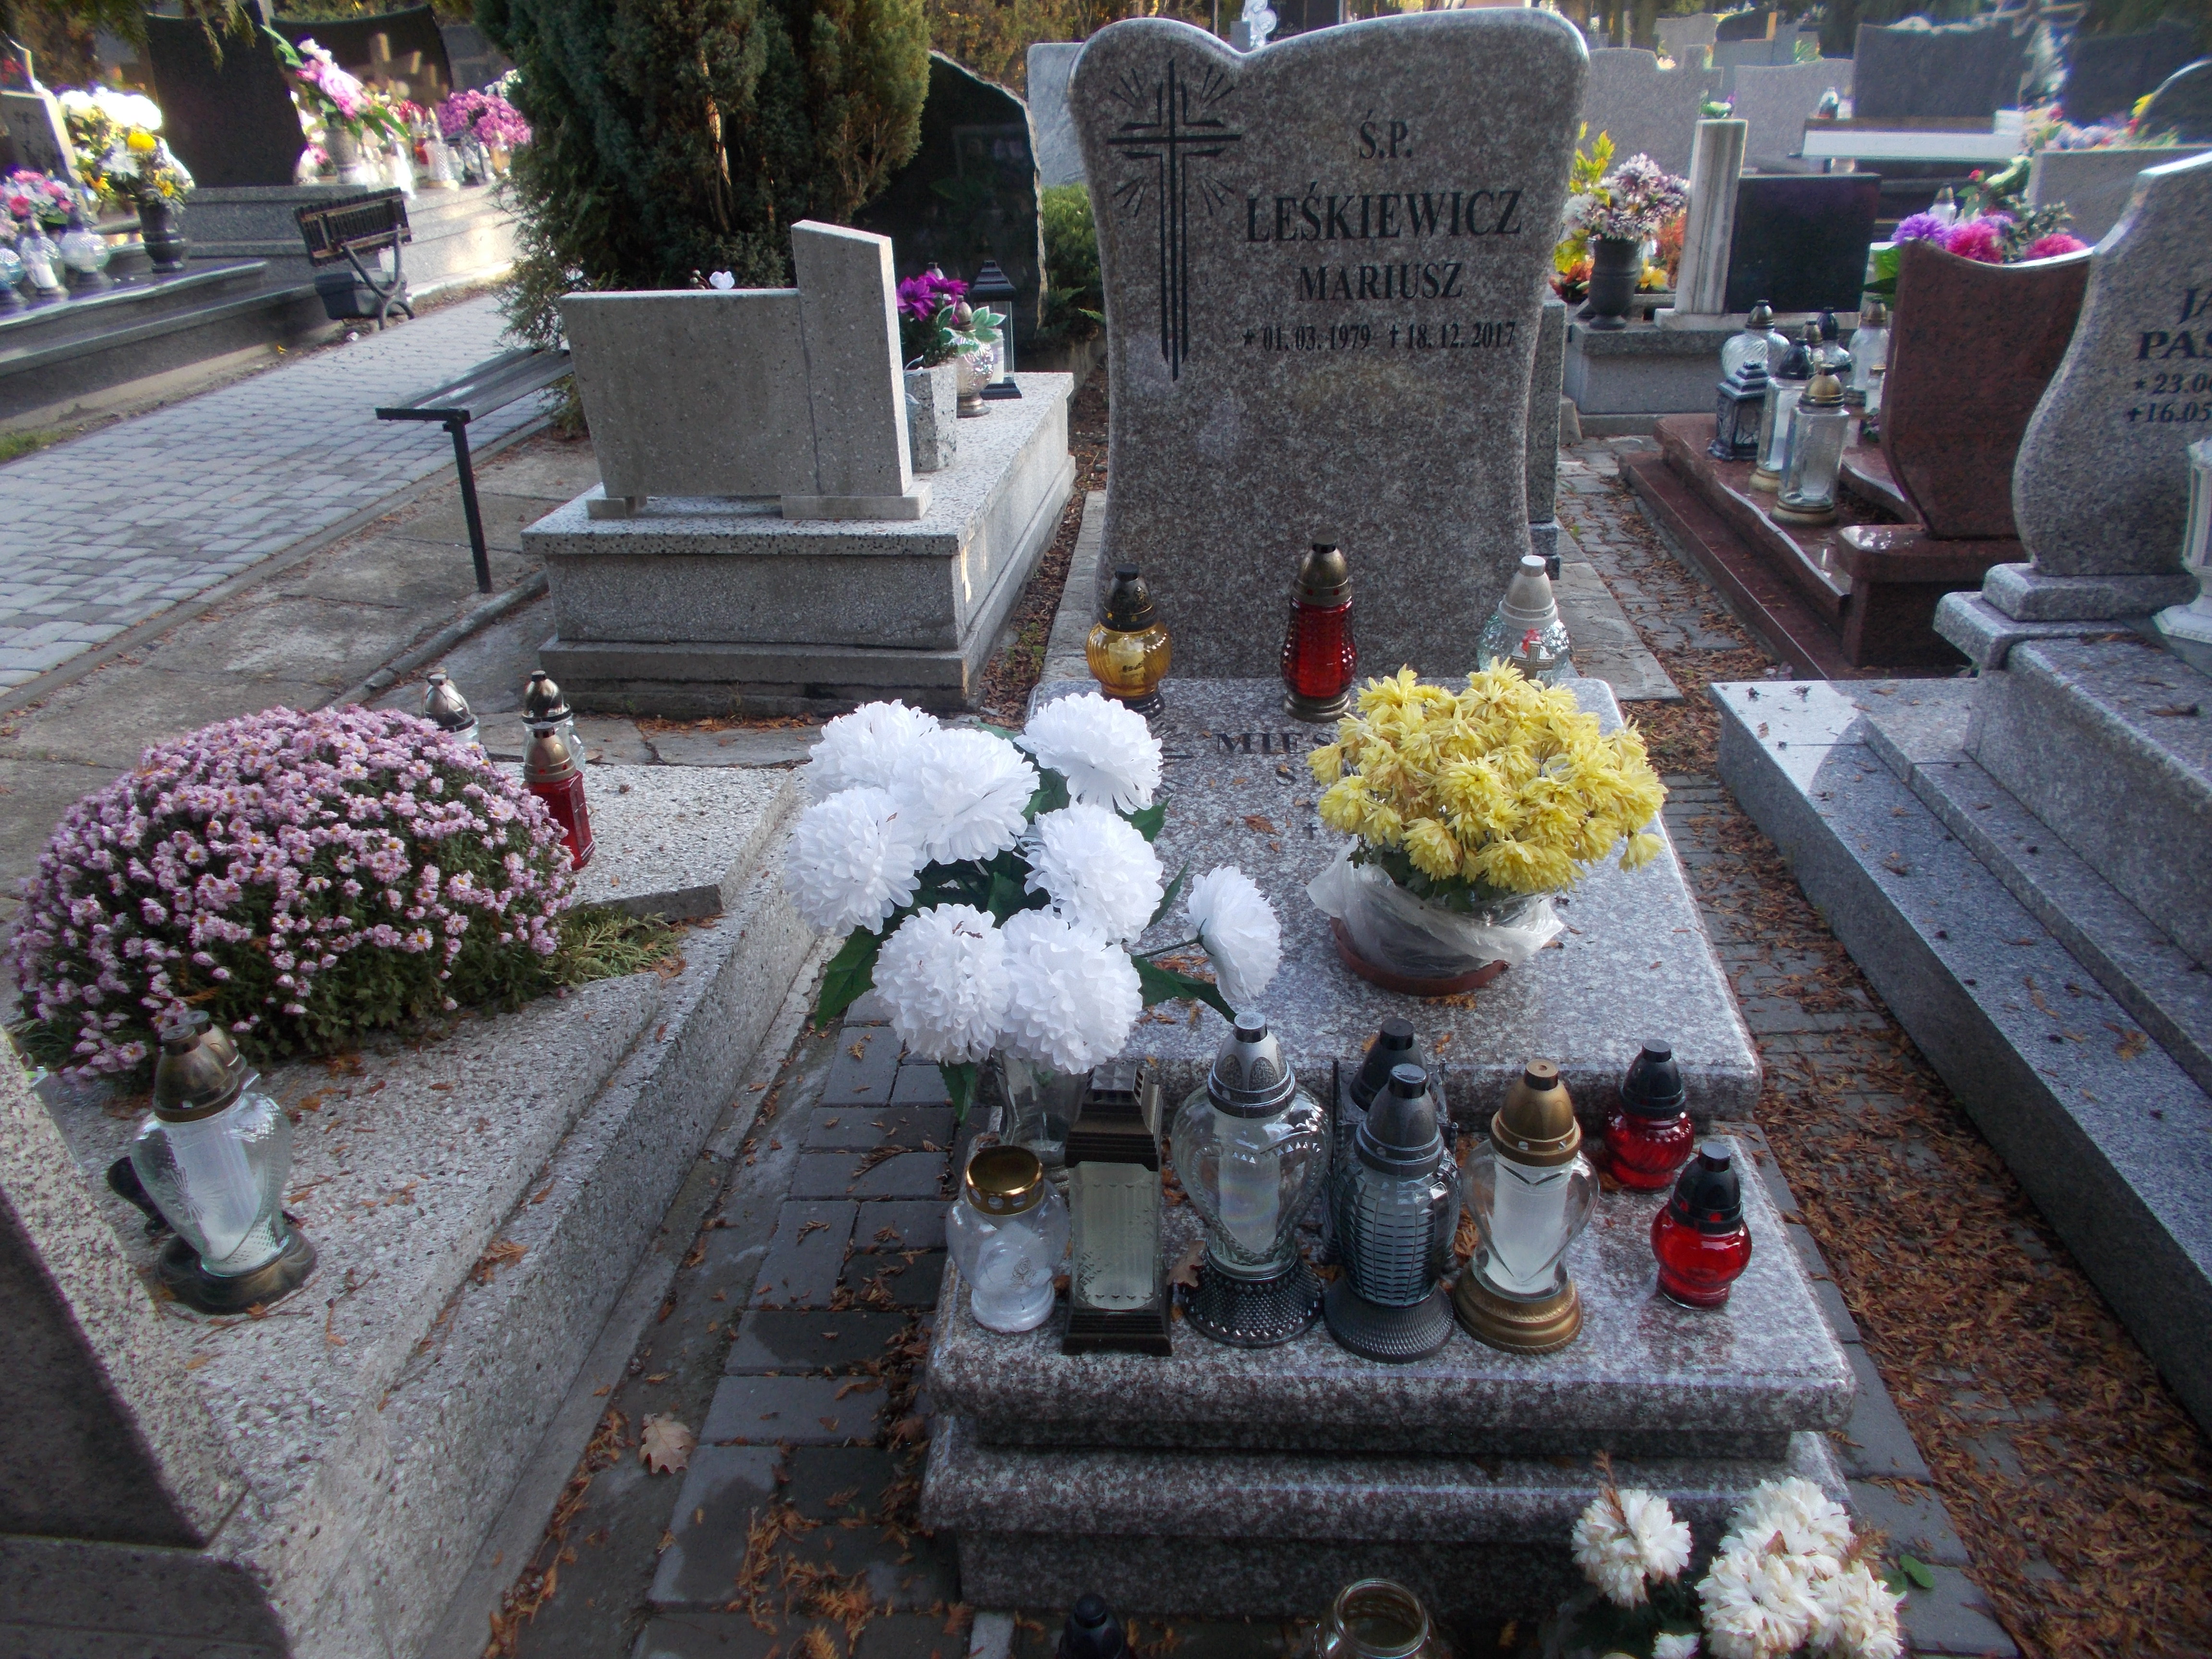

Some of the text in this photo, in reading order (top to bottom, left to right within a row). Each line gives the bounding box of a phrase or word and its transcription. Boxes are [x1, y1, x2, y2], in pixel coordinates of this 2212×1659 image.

[1359, 109, 1412, 159] Ś.P.
[1244, 180, 1523, 241] LEŚKIEWICZ
[1297, 262, 1463, 301] MARIUSZ
